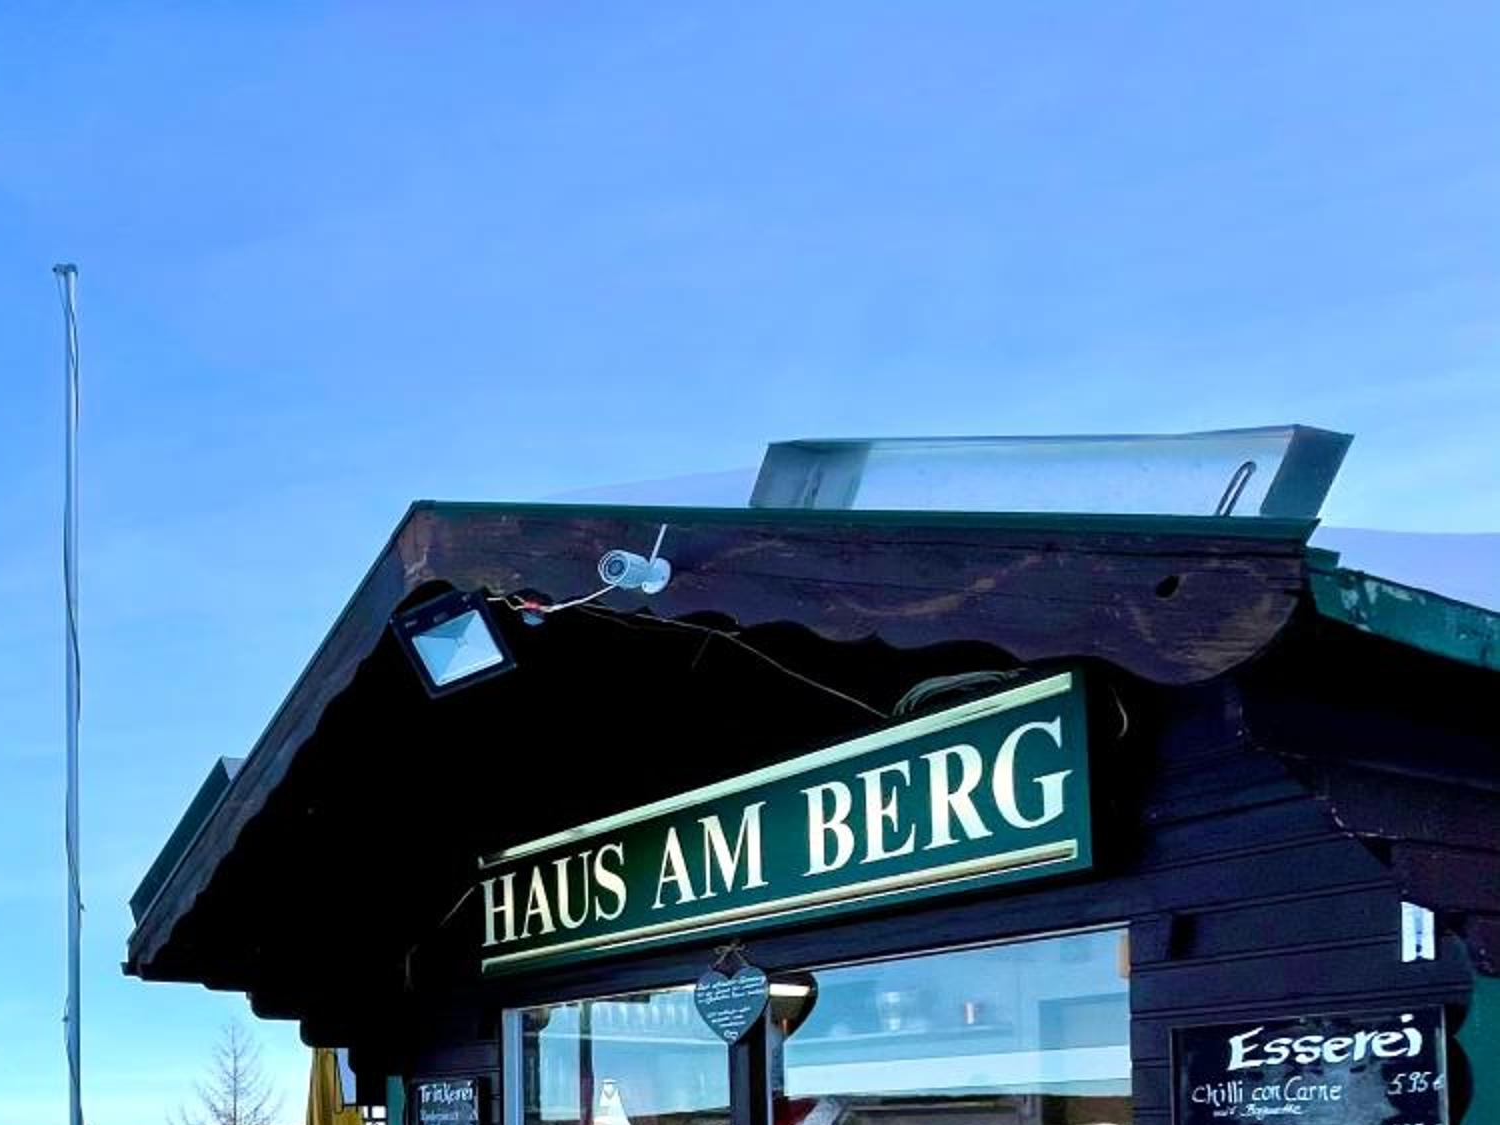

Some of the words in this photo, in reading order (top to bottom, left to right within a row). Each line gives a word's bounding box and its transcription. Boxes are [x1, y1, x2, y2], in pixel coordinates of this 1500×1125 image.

[481, 842, 628, 948] HAUS
[650, 800, 769, 911] AM
[800, 716, 1073, 878] BERG
[1227, 1013, 1423, 1071] Esserei
[1191, 1080, 1243, 1107] Chilli
[1251, 1085, 1281, 1101] con
[1283, 1075, 1343, 1101] Carne
